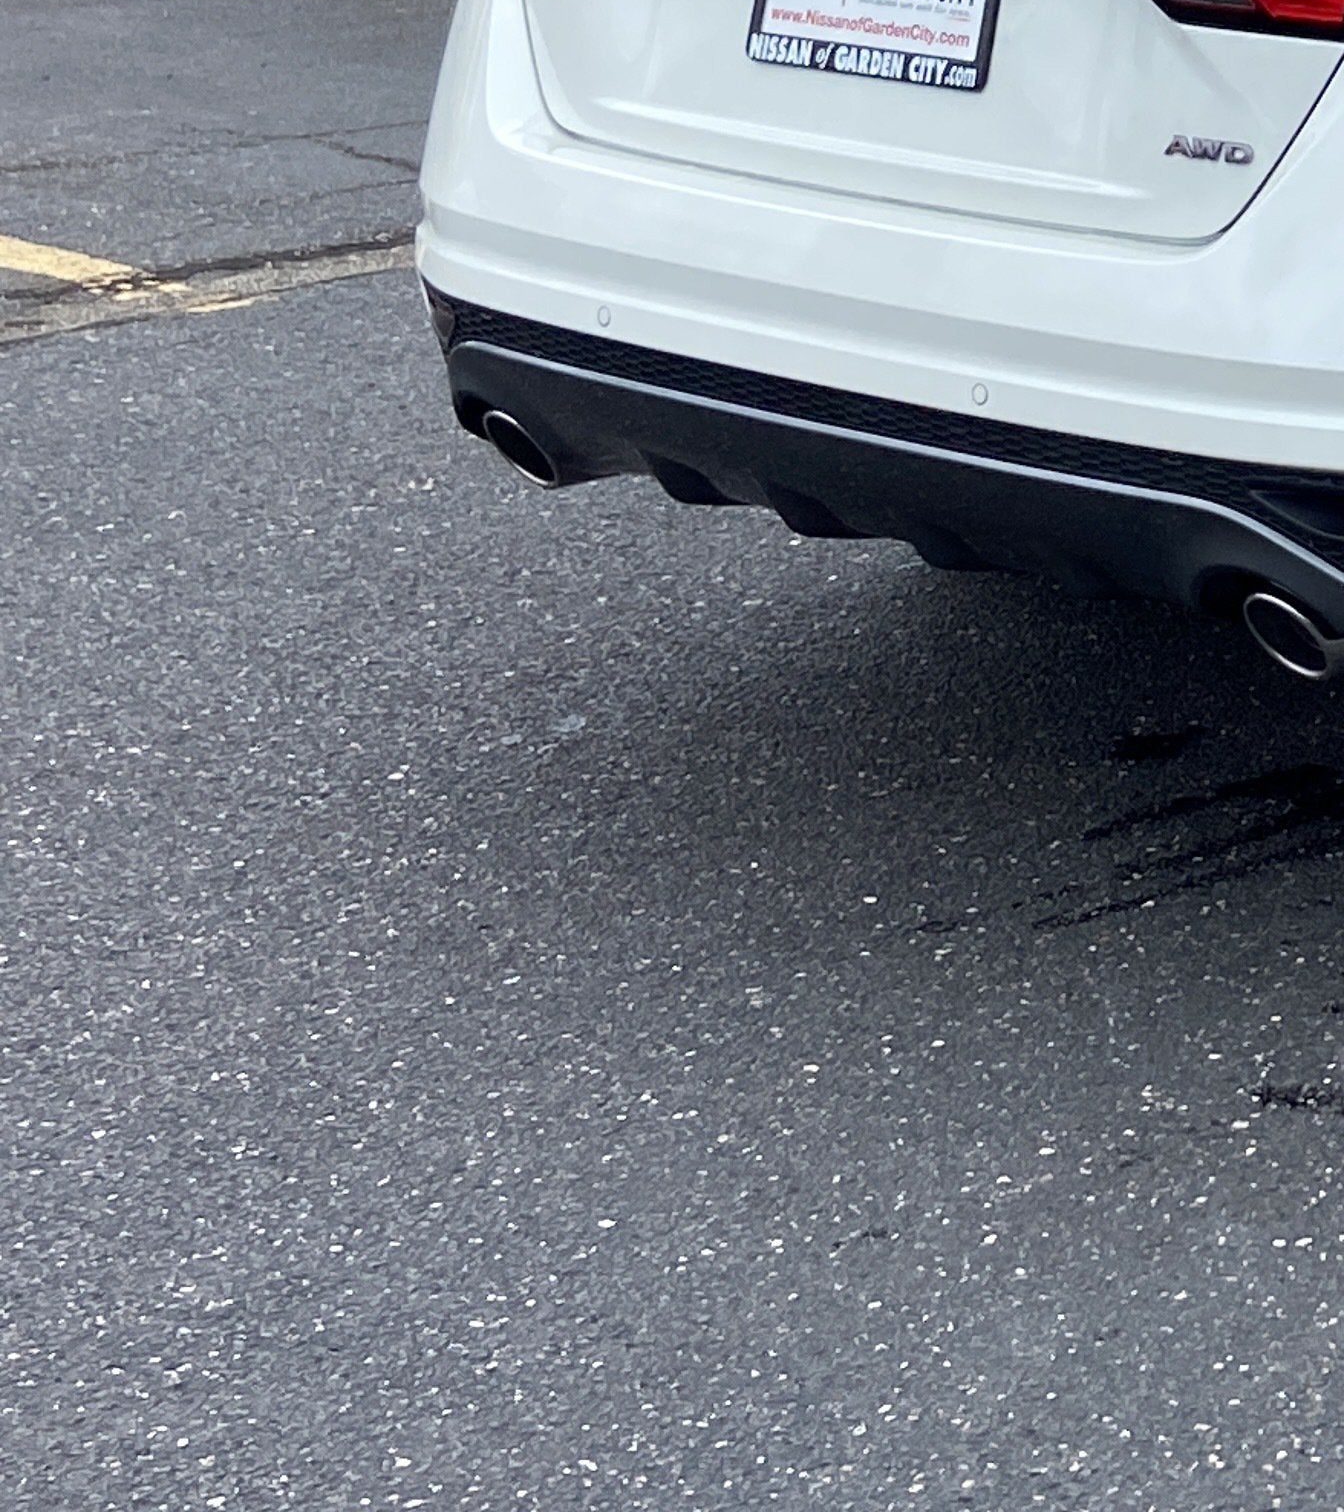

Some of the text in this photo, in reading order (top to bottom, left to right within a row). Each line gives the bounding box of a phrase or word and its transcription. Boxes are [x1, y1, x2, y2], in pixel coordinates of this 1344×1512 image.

[770, 7, 970, 48] www.NissanofGardenCity.com
[749, 33, 814, 67] NISSAN
[815, 43, 834, 70] of
[834, 45, 905, 79] GARDEN
[1164, 134, 1254, 165] AWD
